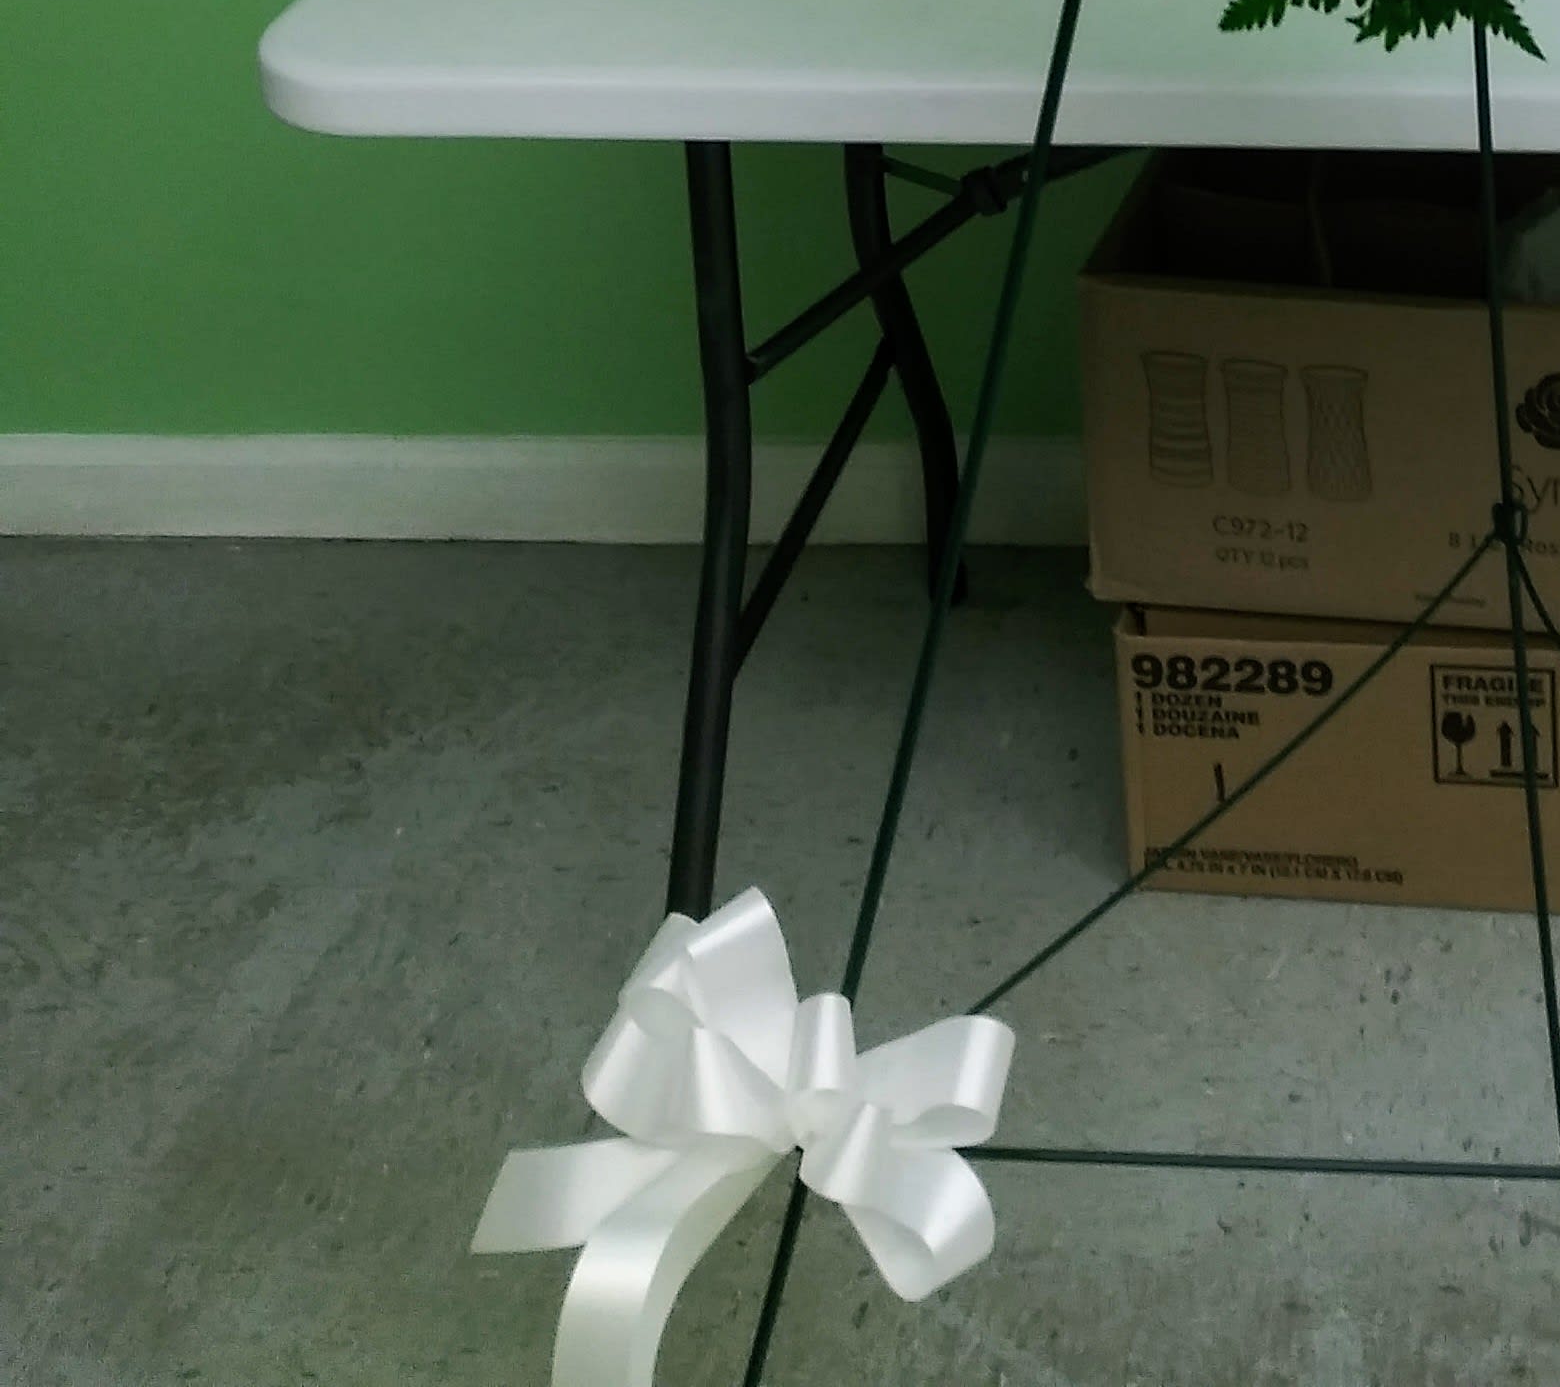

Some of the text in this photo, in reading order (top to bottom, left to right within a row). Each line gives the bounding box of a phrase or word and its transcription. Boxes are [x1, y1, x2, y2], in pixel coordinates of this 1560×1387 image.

[1212, 514, 1310, 543] C972-12
[1215, 546, 1255, 564] QTY
[1130, 652, 1334, 697] 982289
[1442, 674, 1545, 693] FRAGIE
[1151, 692, 1223, 709] DOZEN
[1152, 707, 1260, 726] DOUZAINE
[1153, 723, 1240, 740] DOCENA
